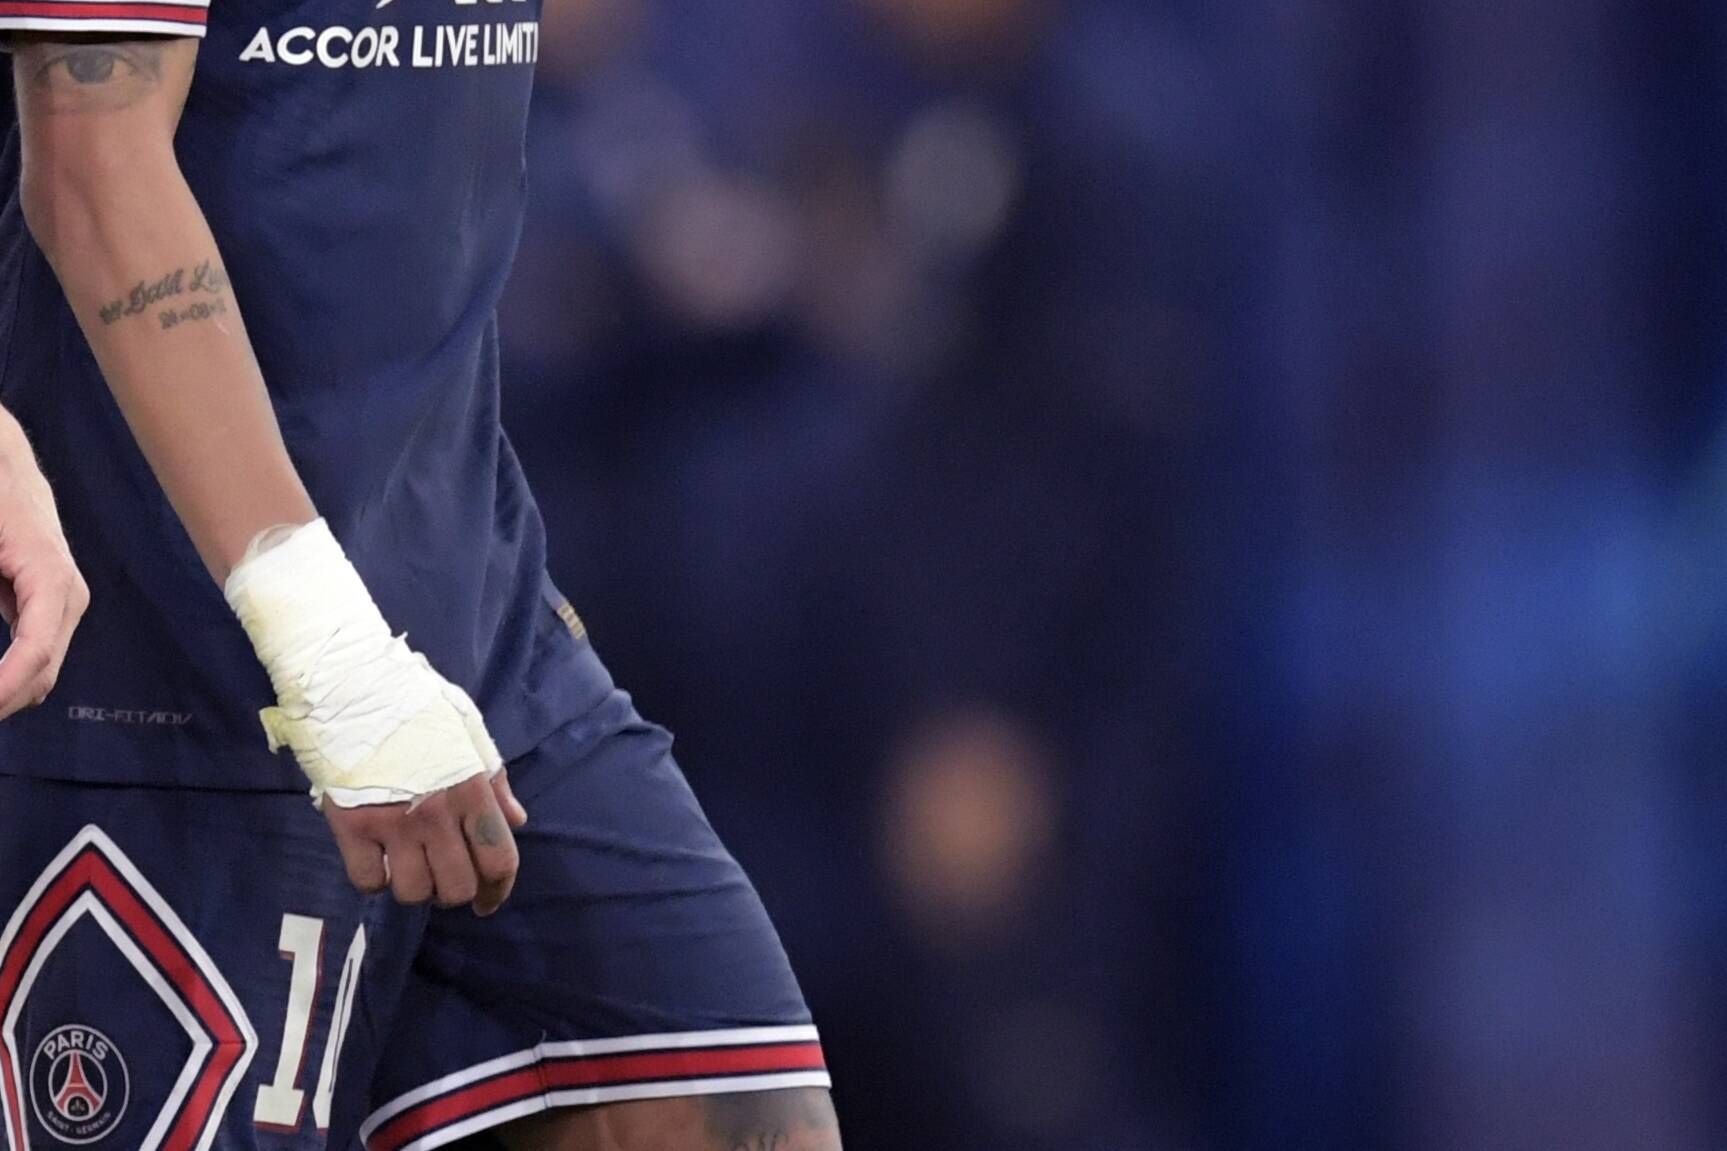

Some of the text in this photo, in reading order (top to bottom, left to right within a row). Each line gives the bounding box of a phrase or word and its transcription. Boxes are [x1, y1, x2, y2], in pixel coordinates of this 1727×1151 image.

[239, 25, 400, 68] ACCOR
[412, 23, 479, 67] LIVE
[42, 1030, 109, 1061] PARIS
